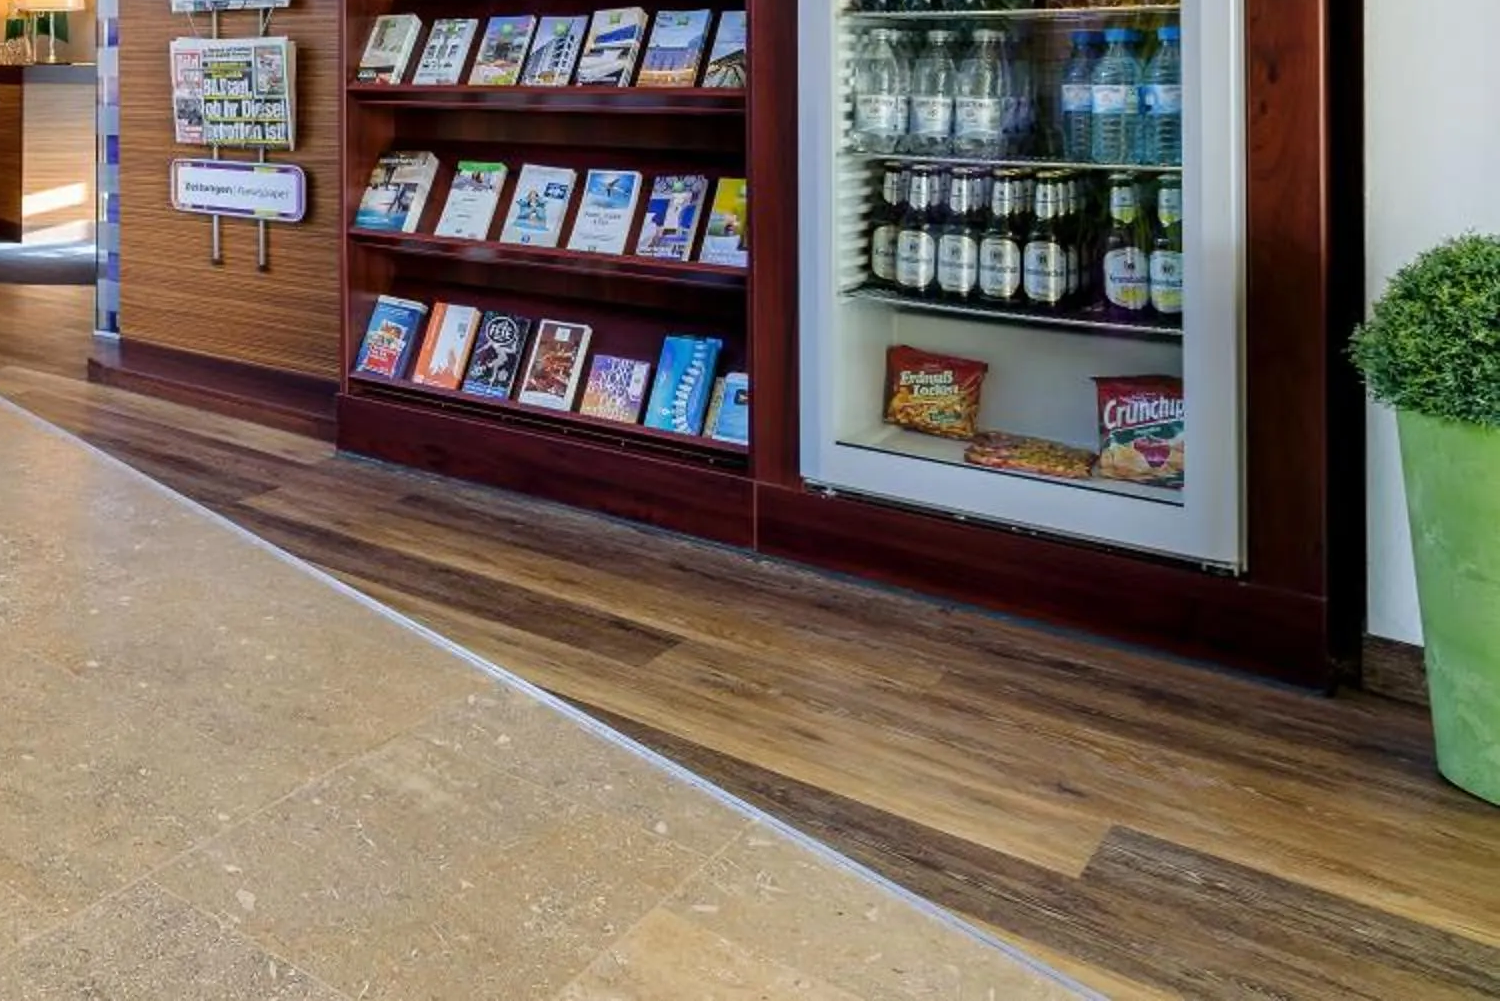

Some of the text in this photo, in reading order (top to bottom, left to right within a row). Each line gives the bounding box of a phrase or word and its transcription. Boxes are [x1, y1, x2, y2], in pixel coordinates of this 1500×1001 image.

[242, 99, 285, 118] Diesel
[185, 182, 233, 195] Zeitungen
[899, 369, 954, 386] Erdnuß
